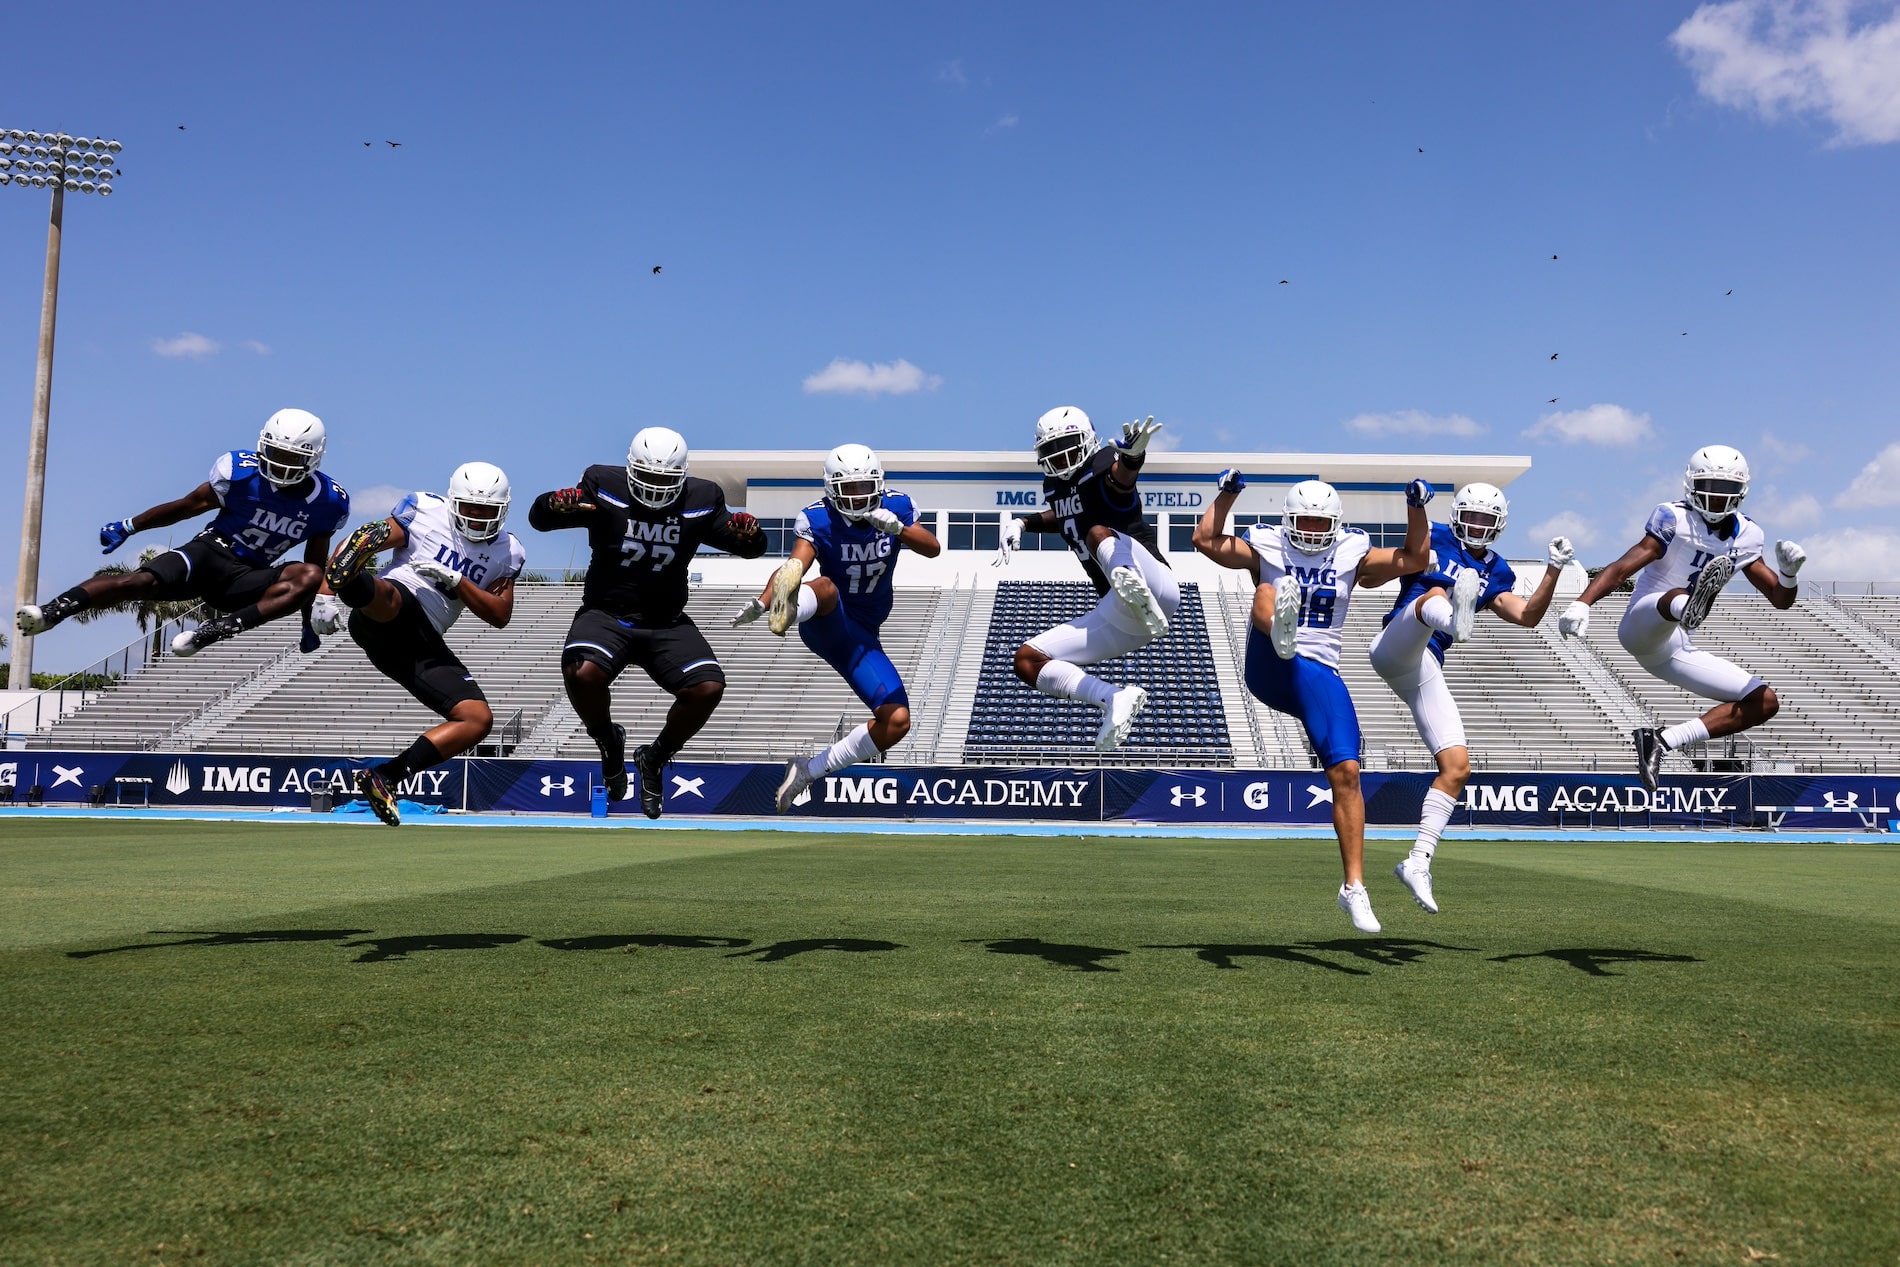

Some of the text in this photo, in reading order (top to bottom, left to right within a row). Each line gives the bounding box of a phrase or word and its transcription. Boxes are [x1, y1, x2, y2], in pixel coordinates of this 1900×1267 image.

[996, 491, 1036, 506] IMG
[1054, 494, 1083, 519] IMG
[1145, 492, 1202, 507] FIELD
[249, 508, 308, 540] IMG
[625, 518, 681, 544] IMG
[841, 537, 891, 562] IMG
[433, 544, 488, 586] IMG
[846, 561, 887, 594] 17
[202, 766, 449, 797] IMG ACAMY
[823, 777, 1089, 807] IMG ACADEMY
[1464, 785, 1729, 813] IMG ACADEMY
